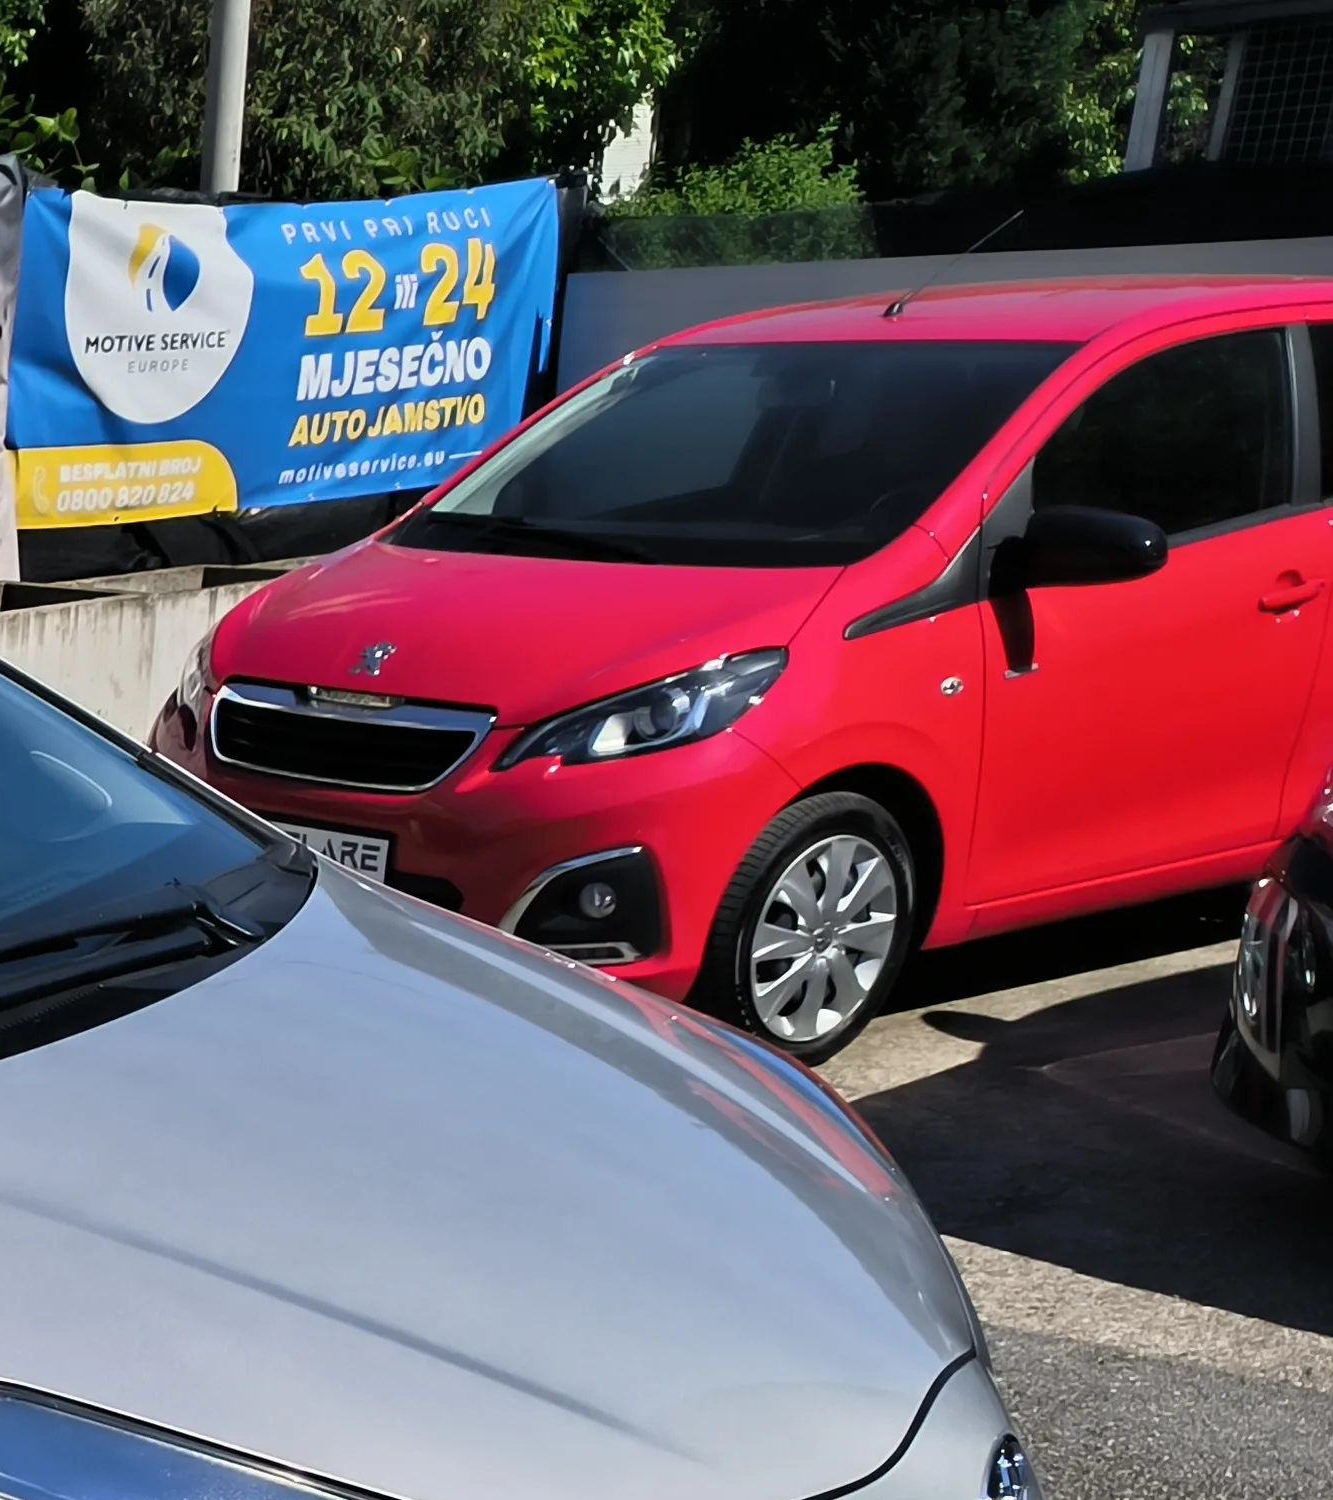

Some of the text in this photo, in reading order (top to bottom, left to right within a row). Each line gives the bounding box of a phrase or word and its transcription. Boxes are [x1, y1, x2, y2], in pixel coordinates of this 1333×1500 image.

[281, 207, 492, 245] PRVI PRI RUCI
[299, 237, 497, 337] 12 ili 24
[84, 330, 227, 354] MOTIVE SERVICE
[127, 358, 190, 374] EUROPE
[296, 330, 493, 402] MJESEČNO
[59, 456, 203, 484] BESPLATNI BROJ
[278, 450, 445, 485] motiveservice.eu
[55, 480, 196, 514] 0800 820 824
